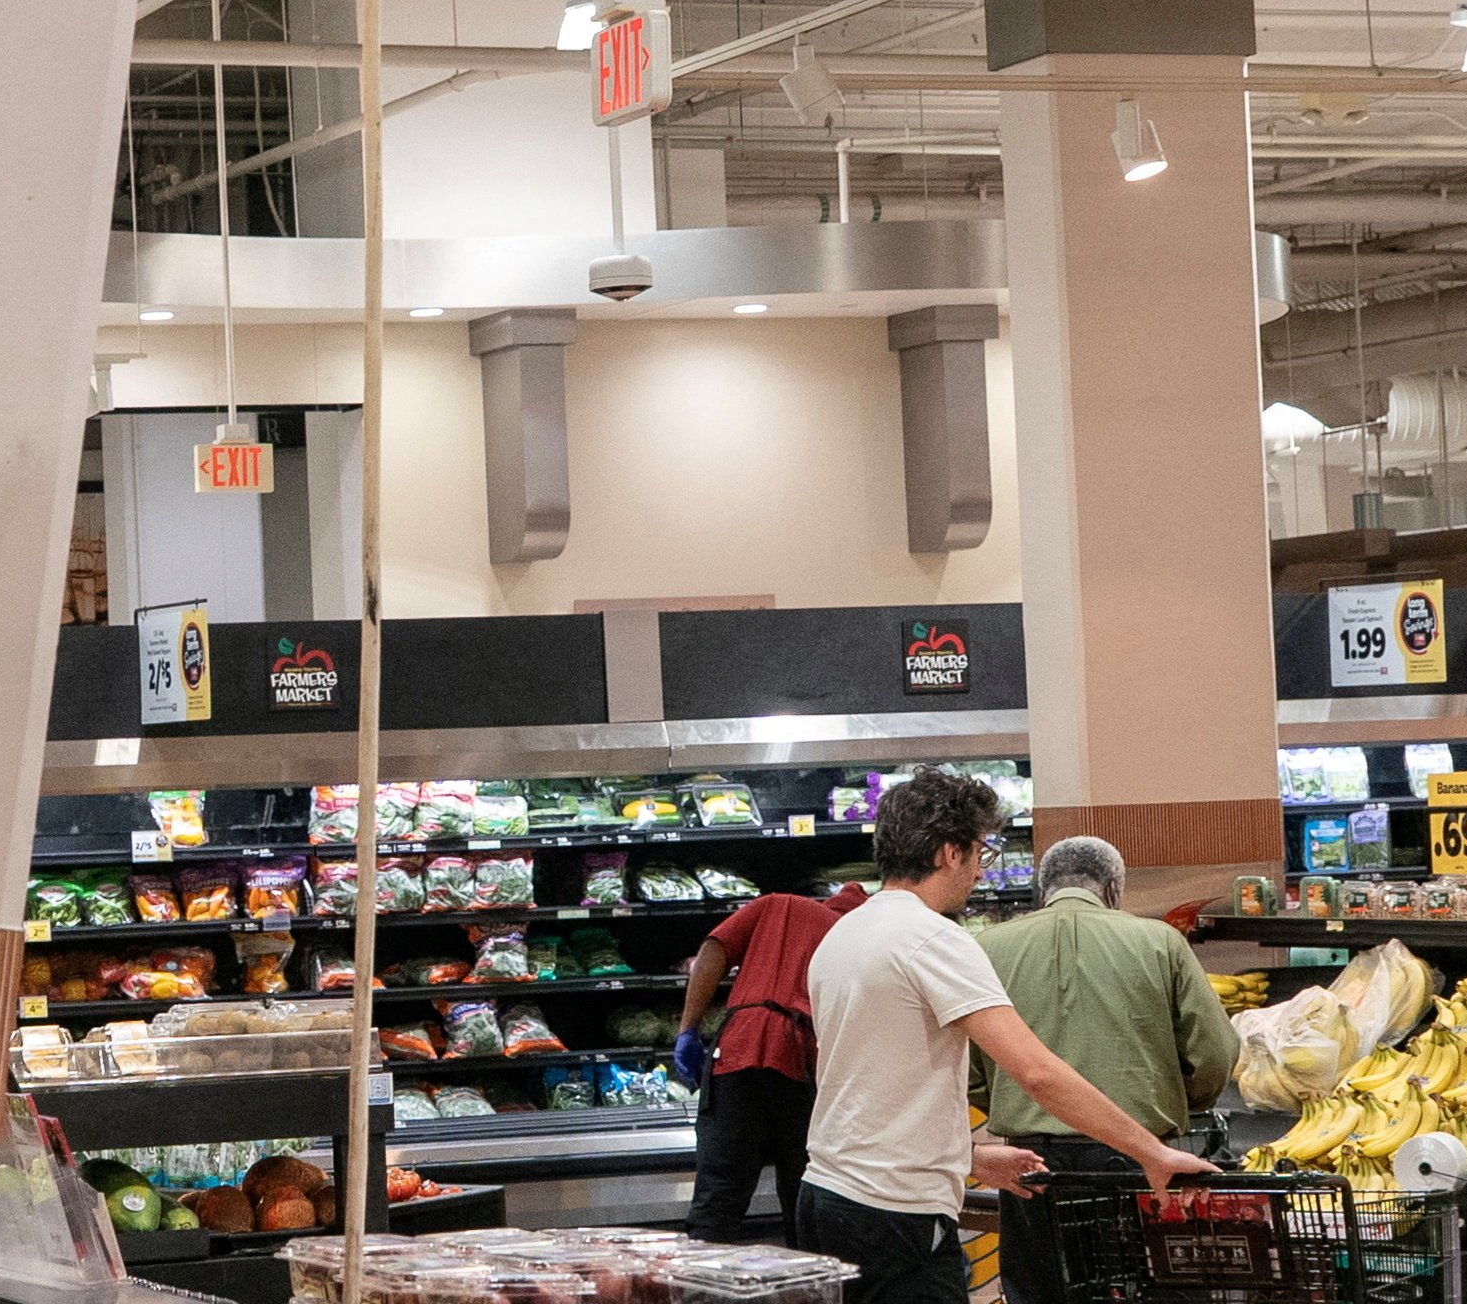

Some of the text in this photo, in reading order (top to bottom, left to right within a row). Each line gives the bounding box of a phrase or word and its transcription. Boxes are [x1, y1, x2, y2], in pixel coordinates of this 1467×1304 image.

[599, 17, 644, 115] EXIT
[212, 447, 262, 487] EXIT
[1339, 627, 1386, 660] 1.99
[906, 655, 968, 670] FARMERS
[271, 671, 338, 688] FARMERS
[910, 670, 963, 684] MARKET
[276, 688, 333, 702] MARKET
